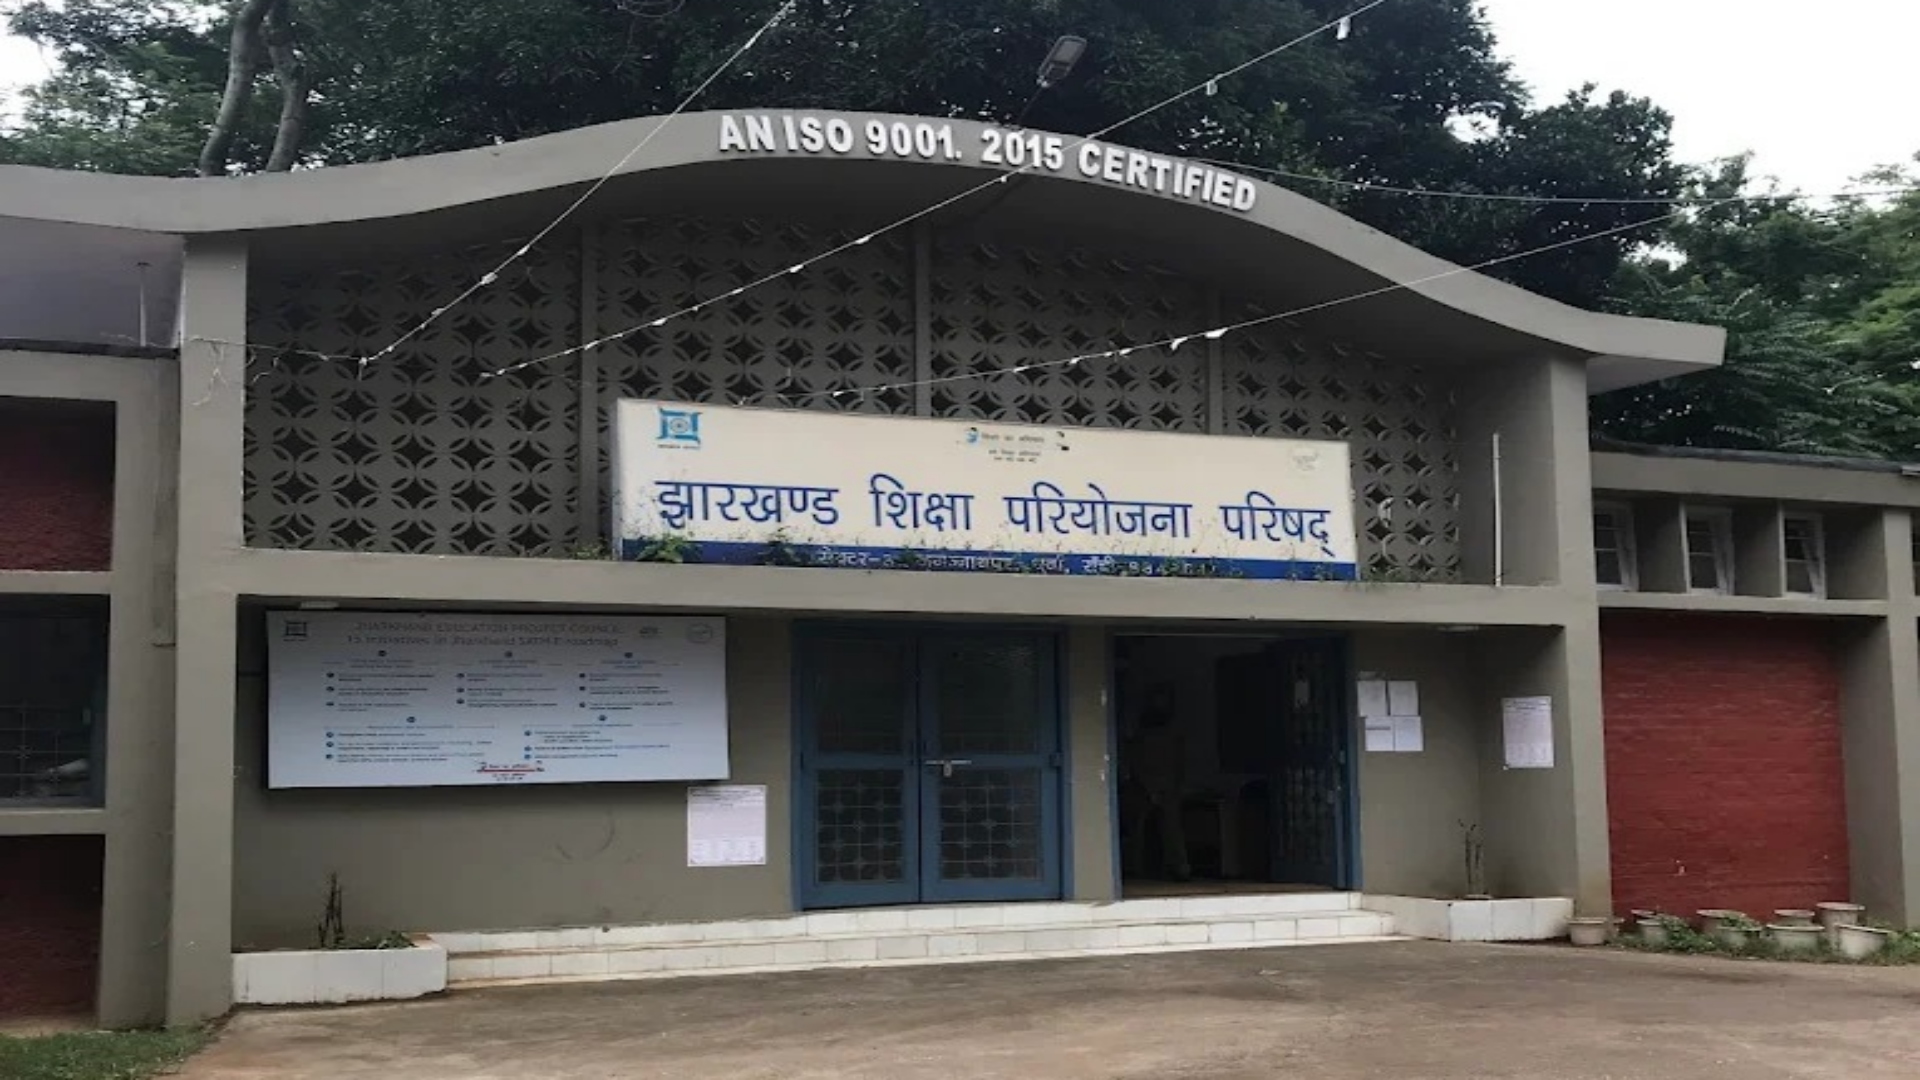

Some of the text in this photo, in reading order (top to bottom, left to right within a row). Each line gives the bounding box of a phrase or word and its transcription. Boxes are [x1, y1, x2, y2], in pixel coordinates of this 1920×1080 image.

[719, 114, 1259, 213] AN ISO 9001. 2015 CERTIFIED
[655, 473, 1338, 558] झारखण्ड शिक्षा परियोजना परिषद्
